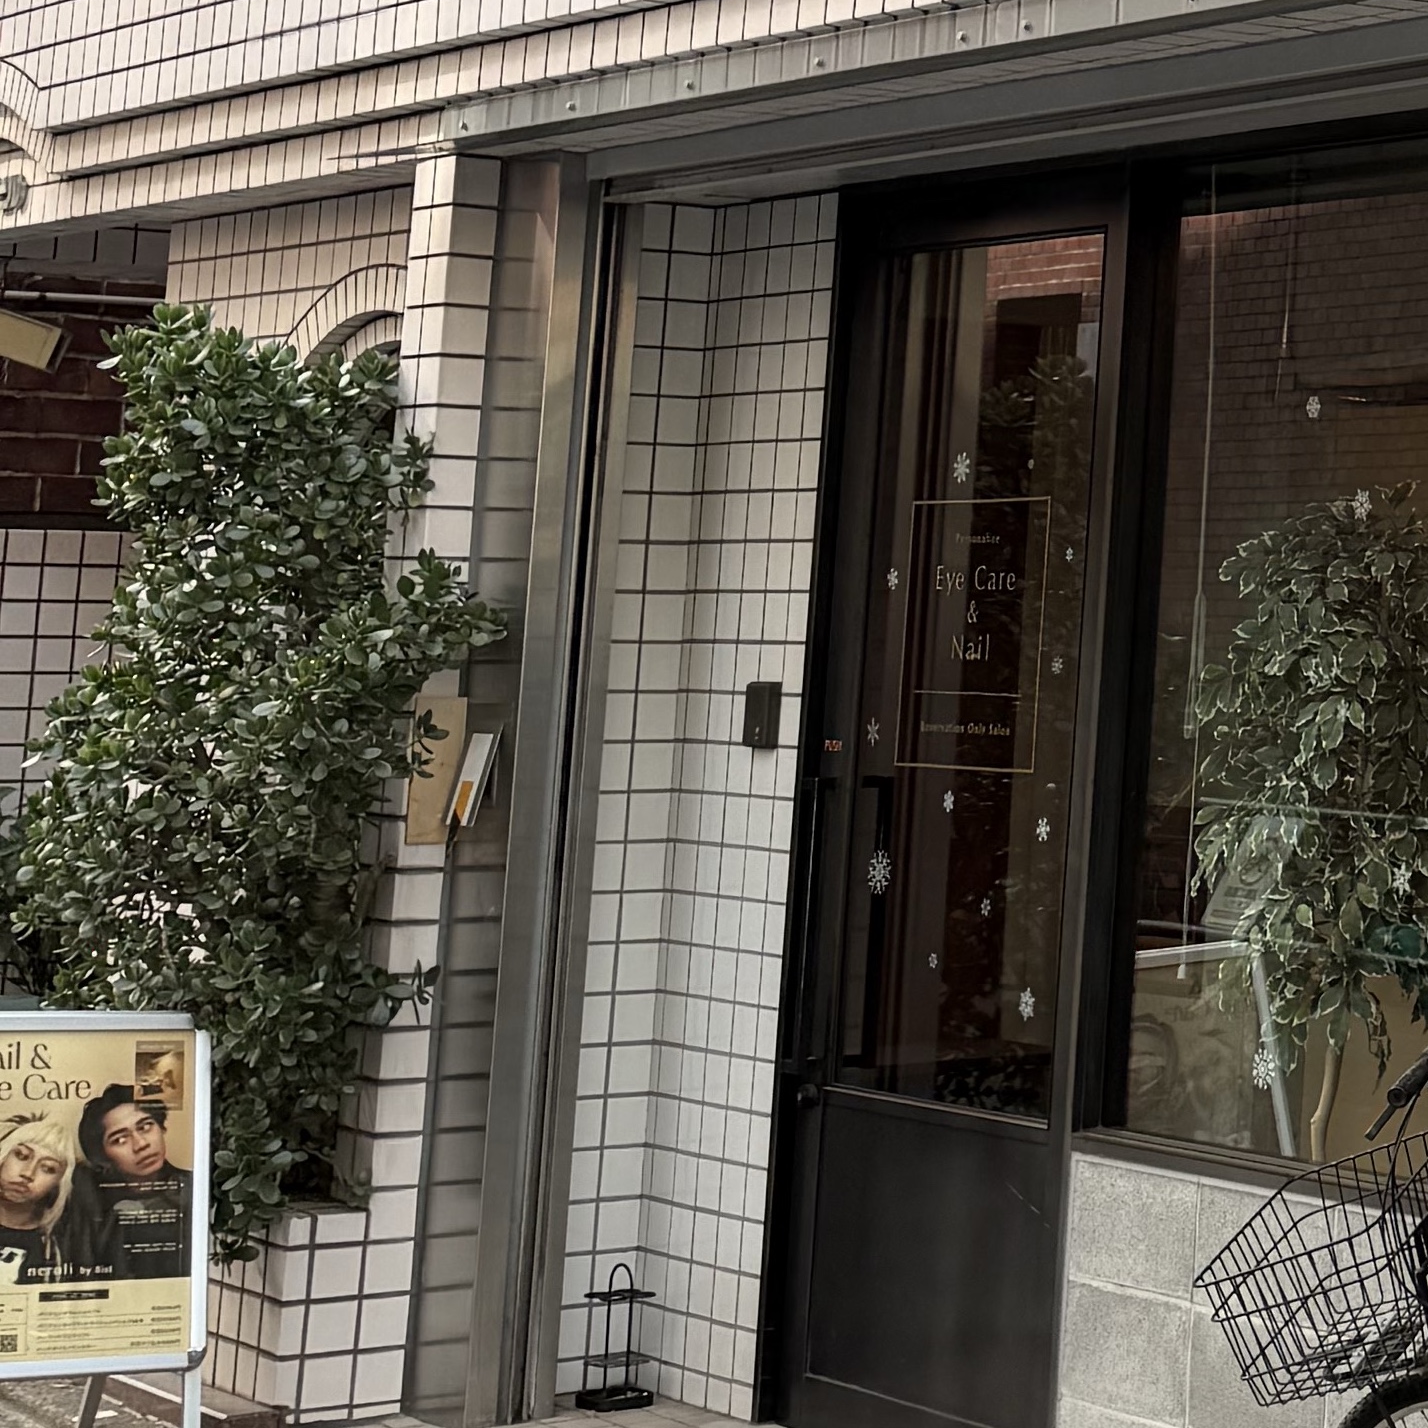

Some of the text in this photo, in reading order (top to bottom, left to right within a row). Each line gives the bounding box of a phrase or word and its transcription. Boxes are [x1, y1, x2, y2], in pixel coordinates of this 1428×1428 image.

[935, 565, 1017, 596] Eye Care
[966, 600, 979, 624] &
[951, 633, 991, 662] Nail
[30, 1042, 52, 1070] &
[23, 1074, 92, 1101] Care
[79, 1265, 93, 1277] by
